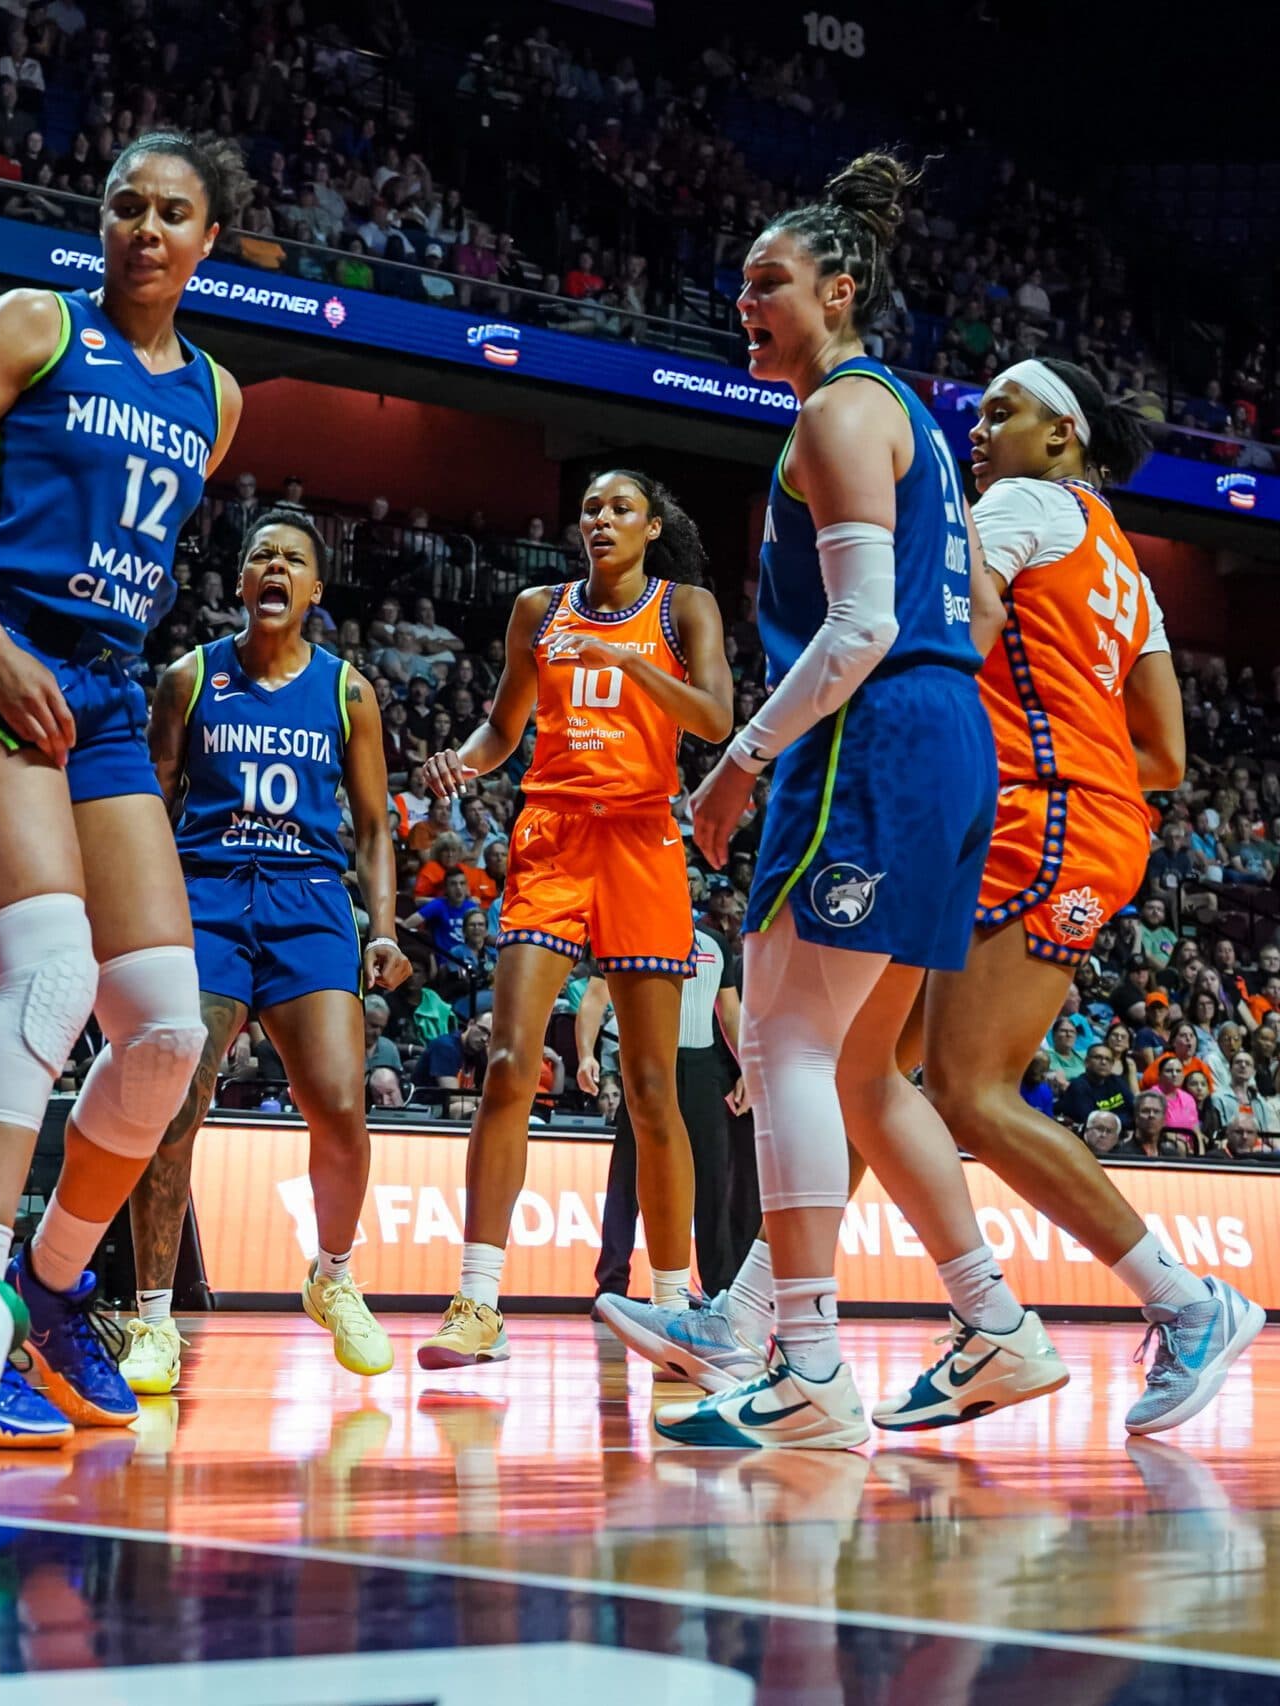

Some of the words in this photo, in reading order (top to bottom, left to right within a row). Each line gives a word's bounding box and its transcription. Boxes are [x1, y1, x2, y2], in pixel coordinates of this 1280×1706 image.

[803, 11, 865, 58] 108
[51, 248, 105, 273] OFFIC
[185, 275, 229, 298] DOG
[230, 283, 320, 316] PARTNER
[653, 369, 722, 397] OFFICIAL
[724, 382, 759, 404] HOT
[759, 390, 795, 411] DOG
[120, 454, 179, 542] 12
[88, 541, 164, 591] MAYO
[68, 573, 153, 623] CLINIC
[1088, 535, 1140, 643] 33
[571, 666, 624, 708] 10
[567, 716, 588, 726] Yale
[567, 728, 625, 739] NewHaven
[203, 724, 330, 764] MINNESOTA
[568, 739, 604, 750] Health
[240, 761, 298, 815] 10
[221, 829, 311, 856] CLINIC
[231, 812, 301, 837] MAYO
[977, 1206, 1094, 1262] OVE
[1143, 1212, 1253, 1268] ANS
